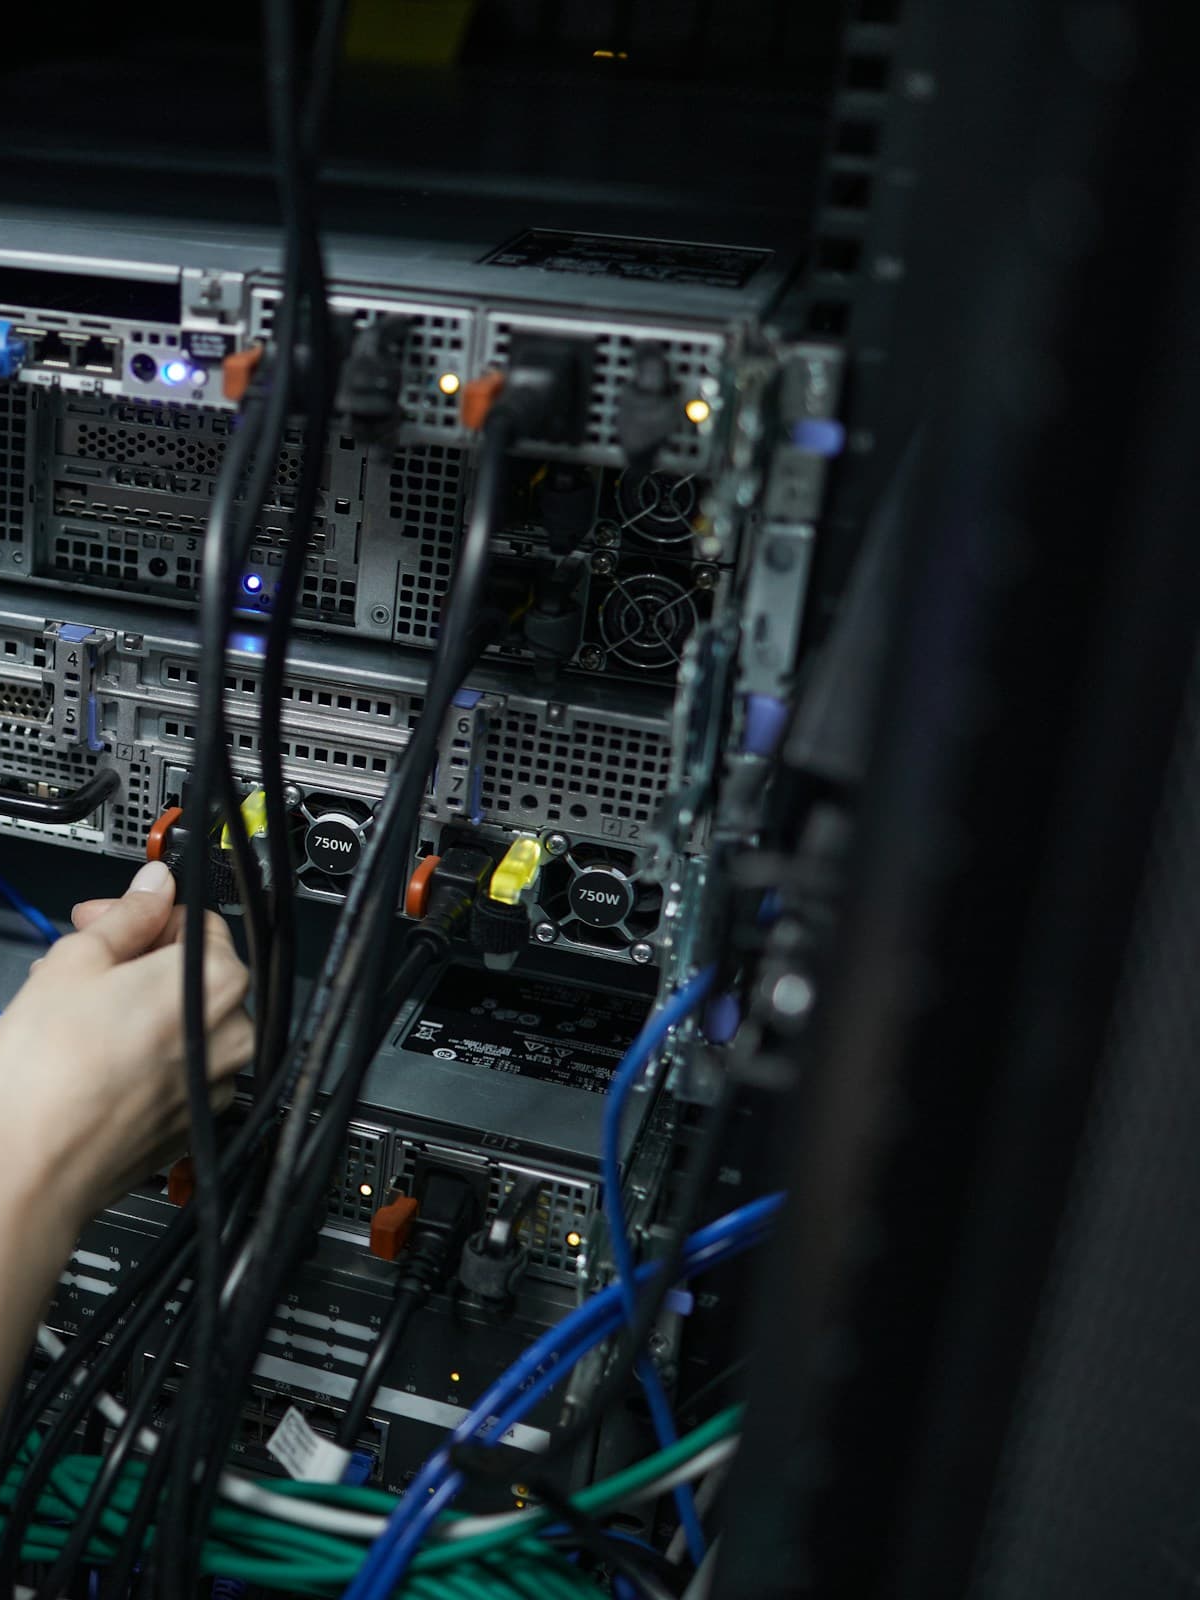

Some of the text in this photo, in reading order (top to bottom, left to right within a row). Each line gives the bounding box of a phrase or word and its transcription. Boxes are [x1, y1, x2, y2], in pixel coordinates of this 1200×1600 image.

[197, 415, 204, 428] 1
[190, 479, 201, 492] 2
[186, 538, 197, 551] 3
[67, 651, 79, 667] 4
[65, 708, 76, 723] 5
[457, 717, 470, 733] 6
[139, 748, 148, 763] 1
[452, 777, 464, 793] 7
[628, 824, 640, 839] 2
[313, 835, 353, 853] 750W
[578, 888, 621, 906] 750W
[109, 1246, 119, 1255] 18
[68, 1291, 79, 1300] 41
[288, 1293, 299, 1303] 22
[81, 1307, 96, 1317] Off
[328, 1304, 340, 1314] 23
[63, 1320, 79, 1332] 17X
[369, 1315, 381, 1325] 24
